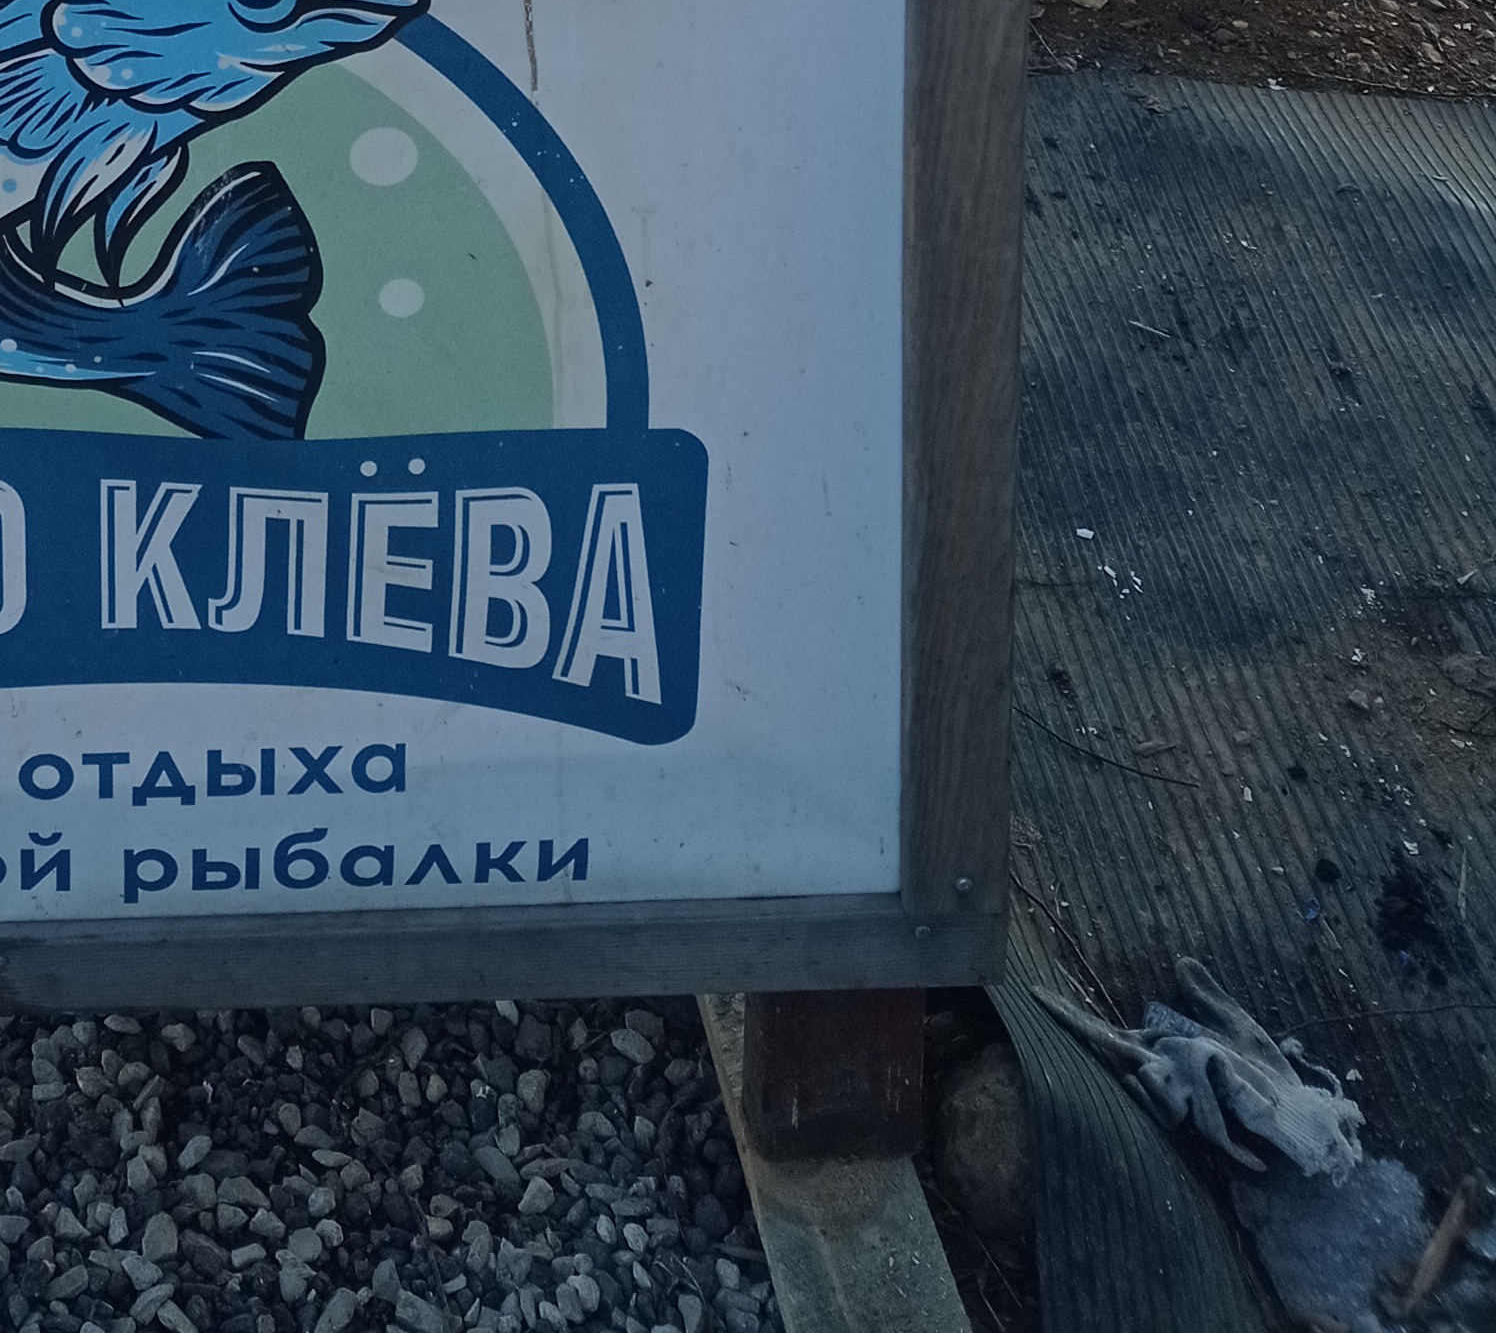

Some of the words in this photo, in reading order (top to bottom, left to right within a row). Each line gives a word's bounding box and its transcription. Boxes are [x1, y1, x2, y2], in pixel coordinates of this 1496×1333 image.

[99, 458, 664, 707] КЛЁВА
[17, 742, 409, 808] отдыха
[117, 826, 591, 906] рыбалки
